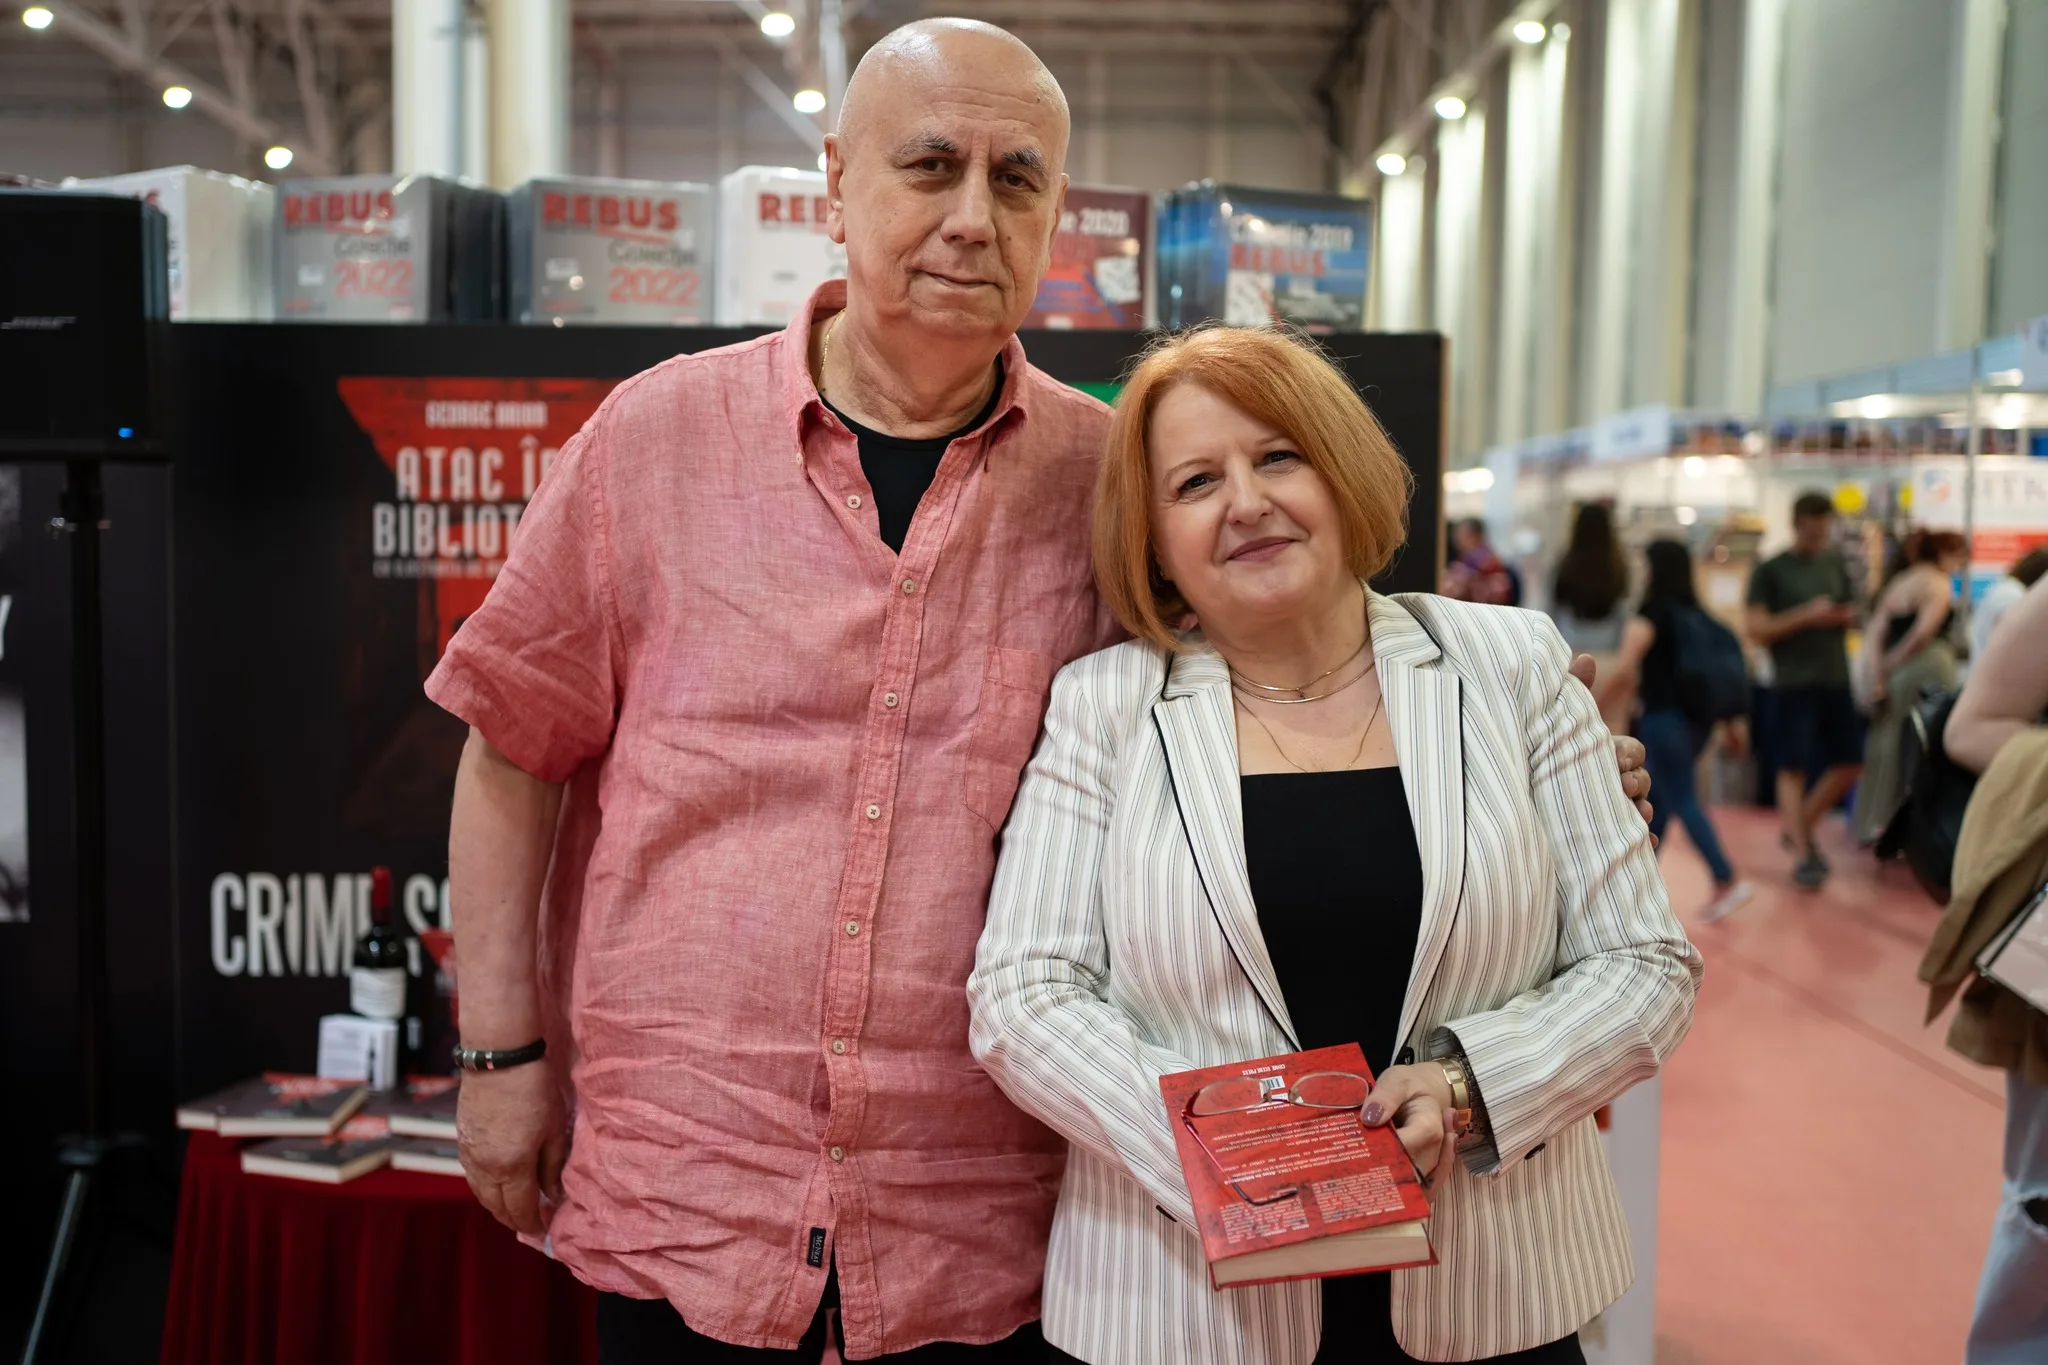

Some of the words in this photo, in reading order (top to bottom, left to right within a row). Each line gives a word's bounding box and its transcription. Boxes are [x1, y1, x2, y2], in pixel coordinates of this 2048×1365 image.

[543, 193, 680, 231] REBUS
[333, 258, 414, 298] 2022
[609, 267, 700, 306] 2022
[396, 447, 504, 500] ATAC
[372, 503, 523, 558] BIBLIOT
